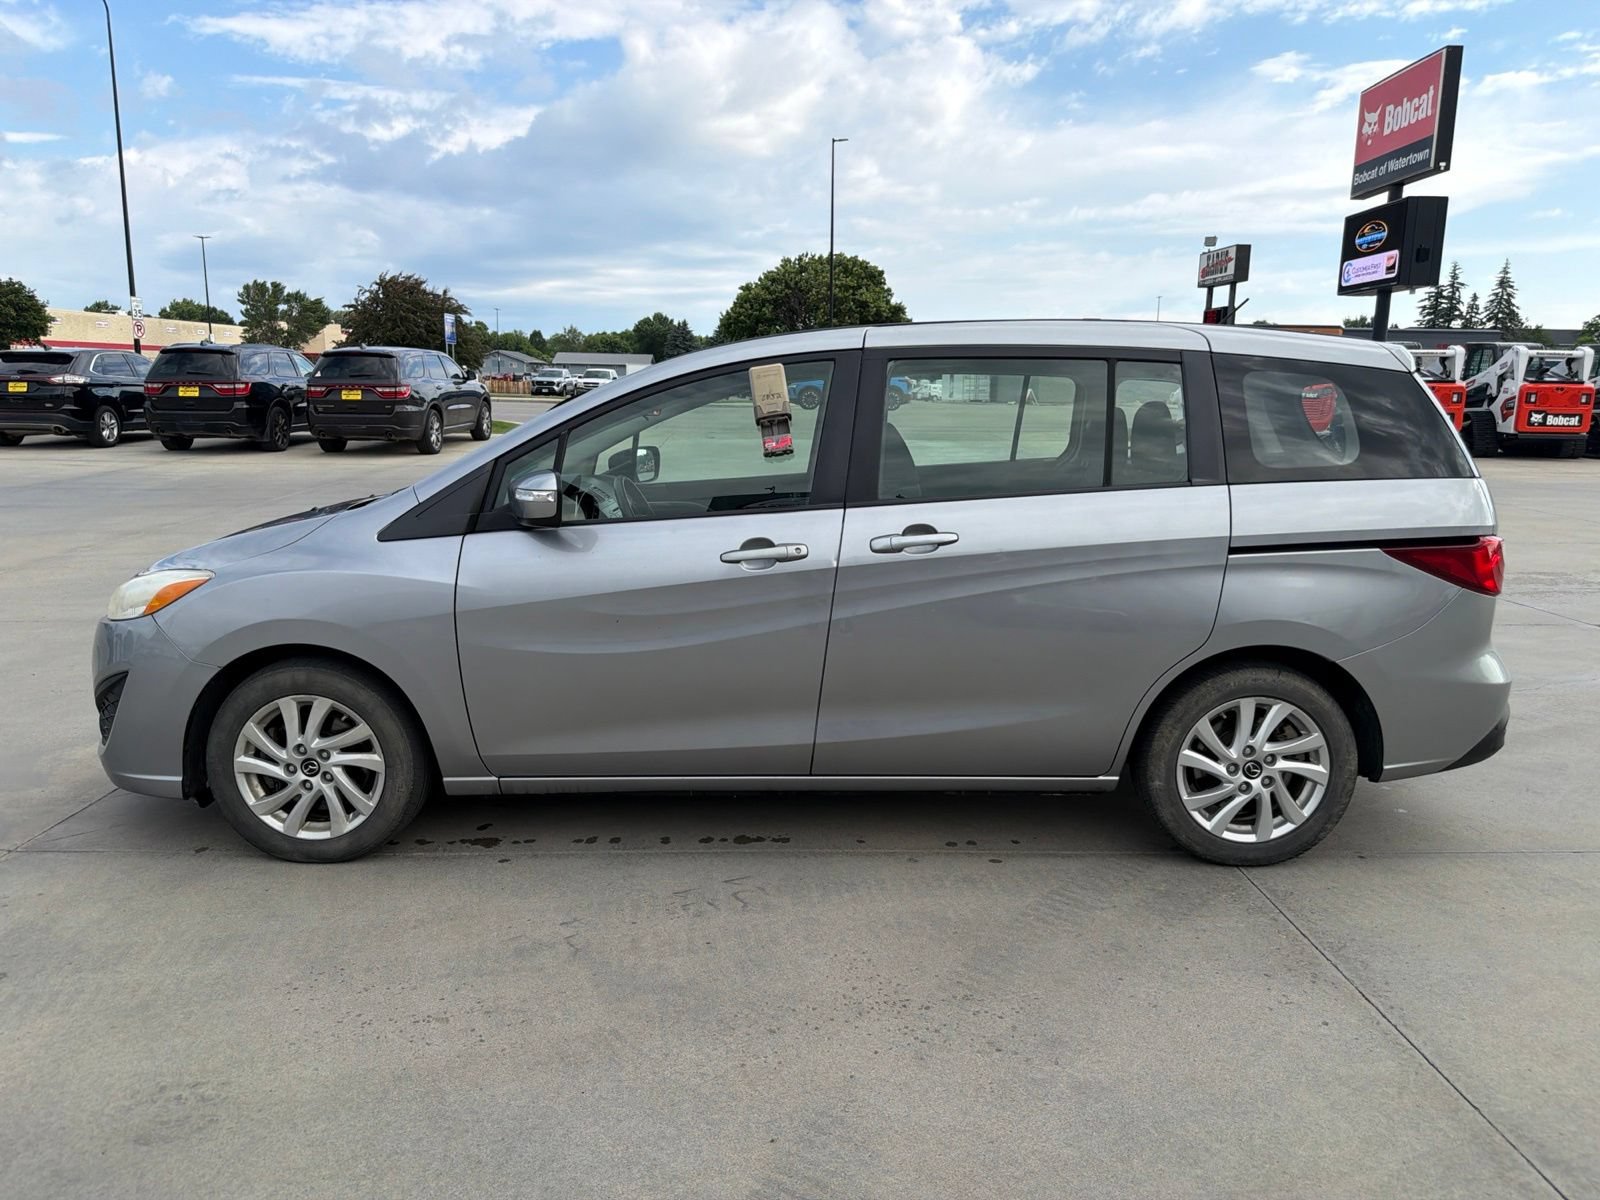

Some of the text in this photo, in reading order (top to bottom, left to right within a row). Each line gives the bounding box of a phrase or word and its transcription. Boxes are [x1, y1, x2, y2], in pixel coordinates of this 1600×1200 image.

[1383, 85, 1434, 136] Bobcat
[1354, 149, 1430, 186] Bobcat of Watertown
[133, 308, 142, 318] 35
[1546, 414, 1580, 426] Bobcat
